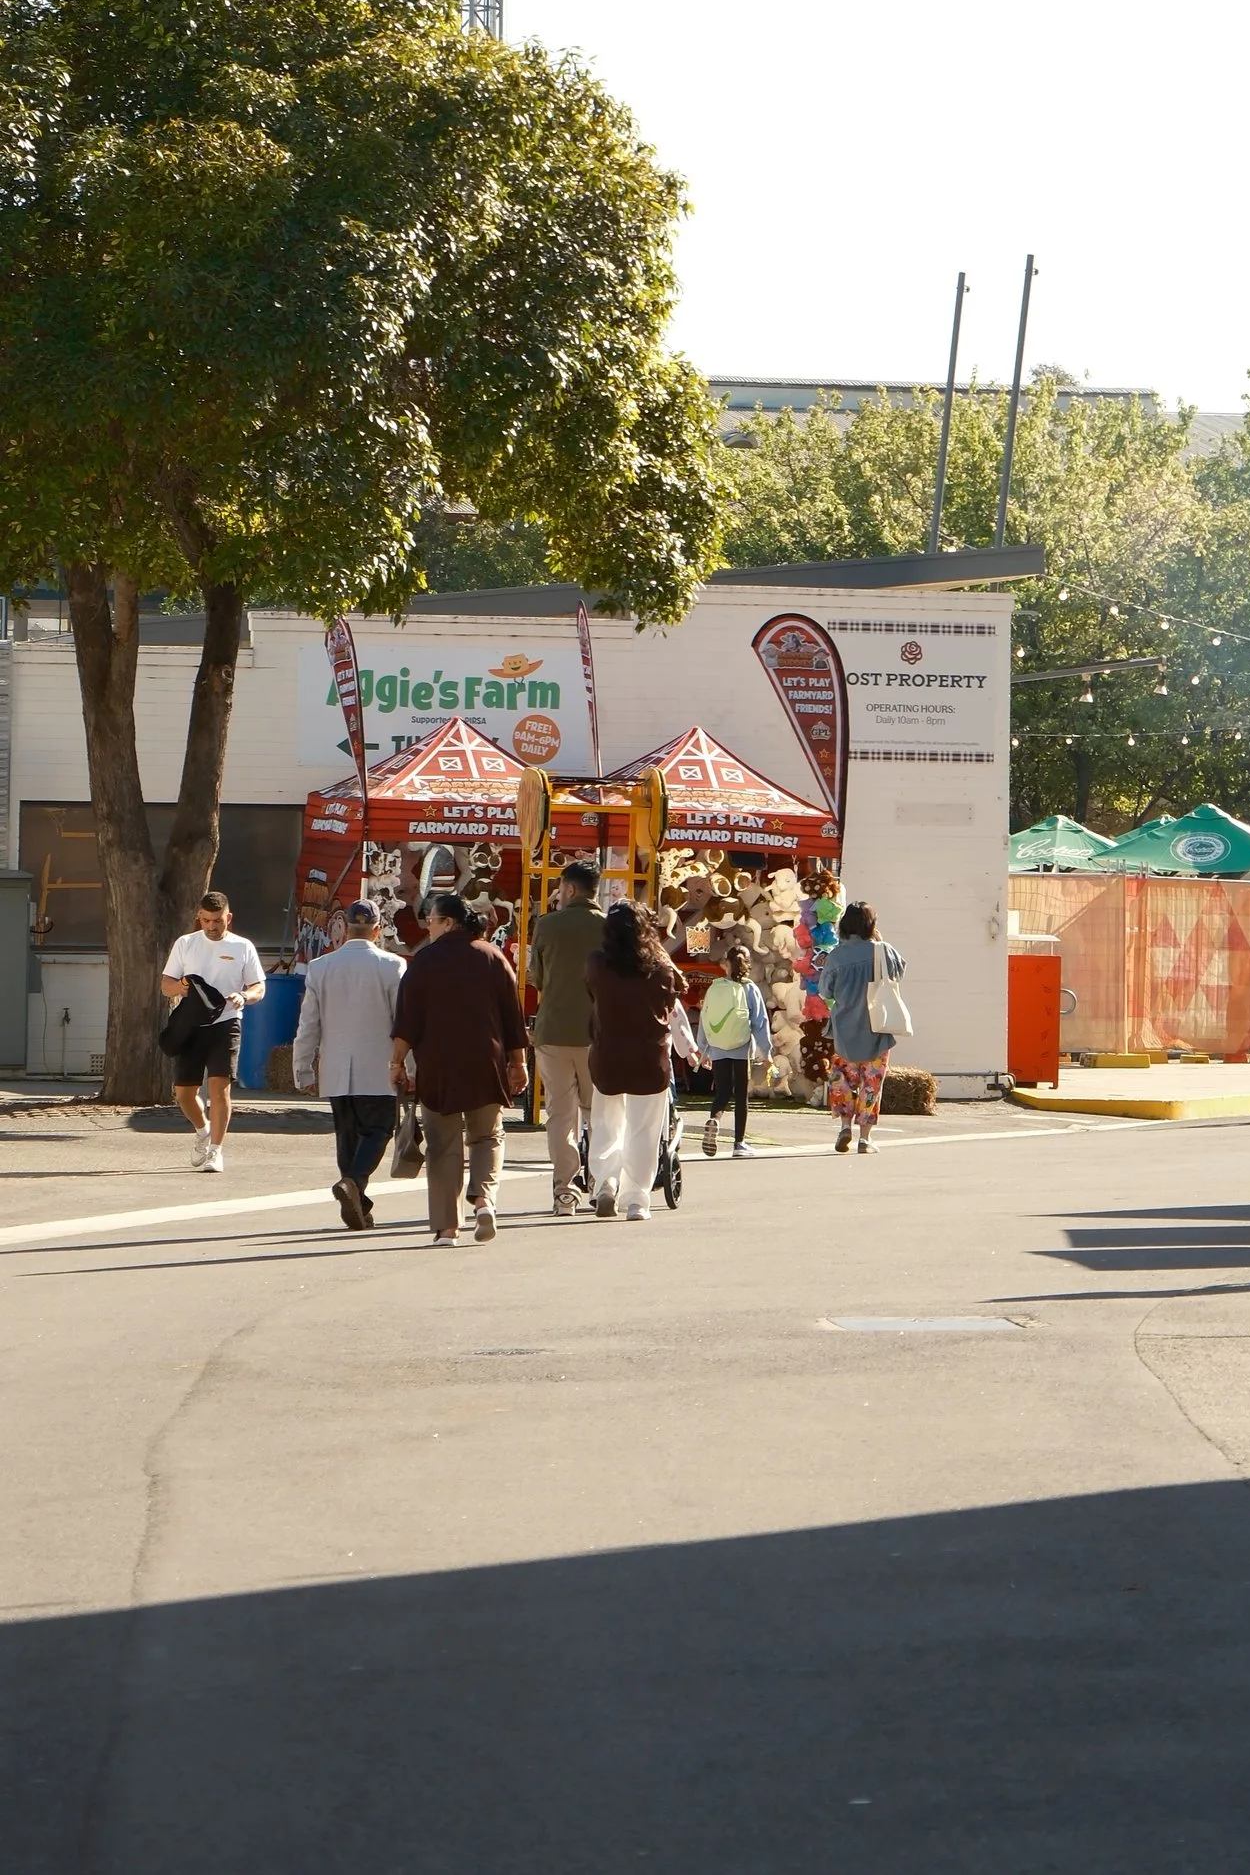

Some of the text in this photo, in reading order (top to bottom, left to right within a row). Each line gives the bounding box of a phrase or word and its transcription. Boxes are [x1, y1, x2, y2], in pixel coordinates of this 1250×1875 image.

[782, 676, 831, 687] LET'S PLAY
[846, 672, 987, 689] OST PROPERTY
[464, 676, 561, 711] Farm
[788, 690, 834, 700] FARMYARD
[795, 703, 833, 714] FRIENDS!
[866, 703, 956, 713] OPERATING HOURS:
[525, 720, 552, 735] FREE!
[875, 715, 896, 725] Daily
[897, 716, 919, 725] 10am
[926, 717, 946, 726] 8pm
[514, 731, 560, 747] 9AM-6PM
[811, 728, 831, 736] GPL
[521, 742, 549, 756] DAILY
[442, 803, 485, 819] LET'S
[686, 811, 765, 828] LET'S PLAY
[408, 822, 557, 840] FARMYARD FRIE!
[665, 829, 799, 849] ARMYARD FRIENDS!
[1016, 838, 1094, 859] Coopers
